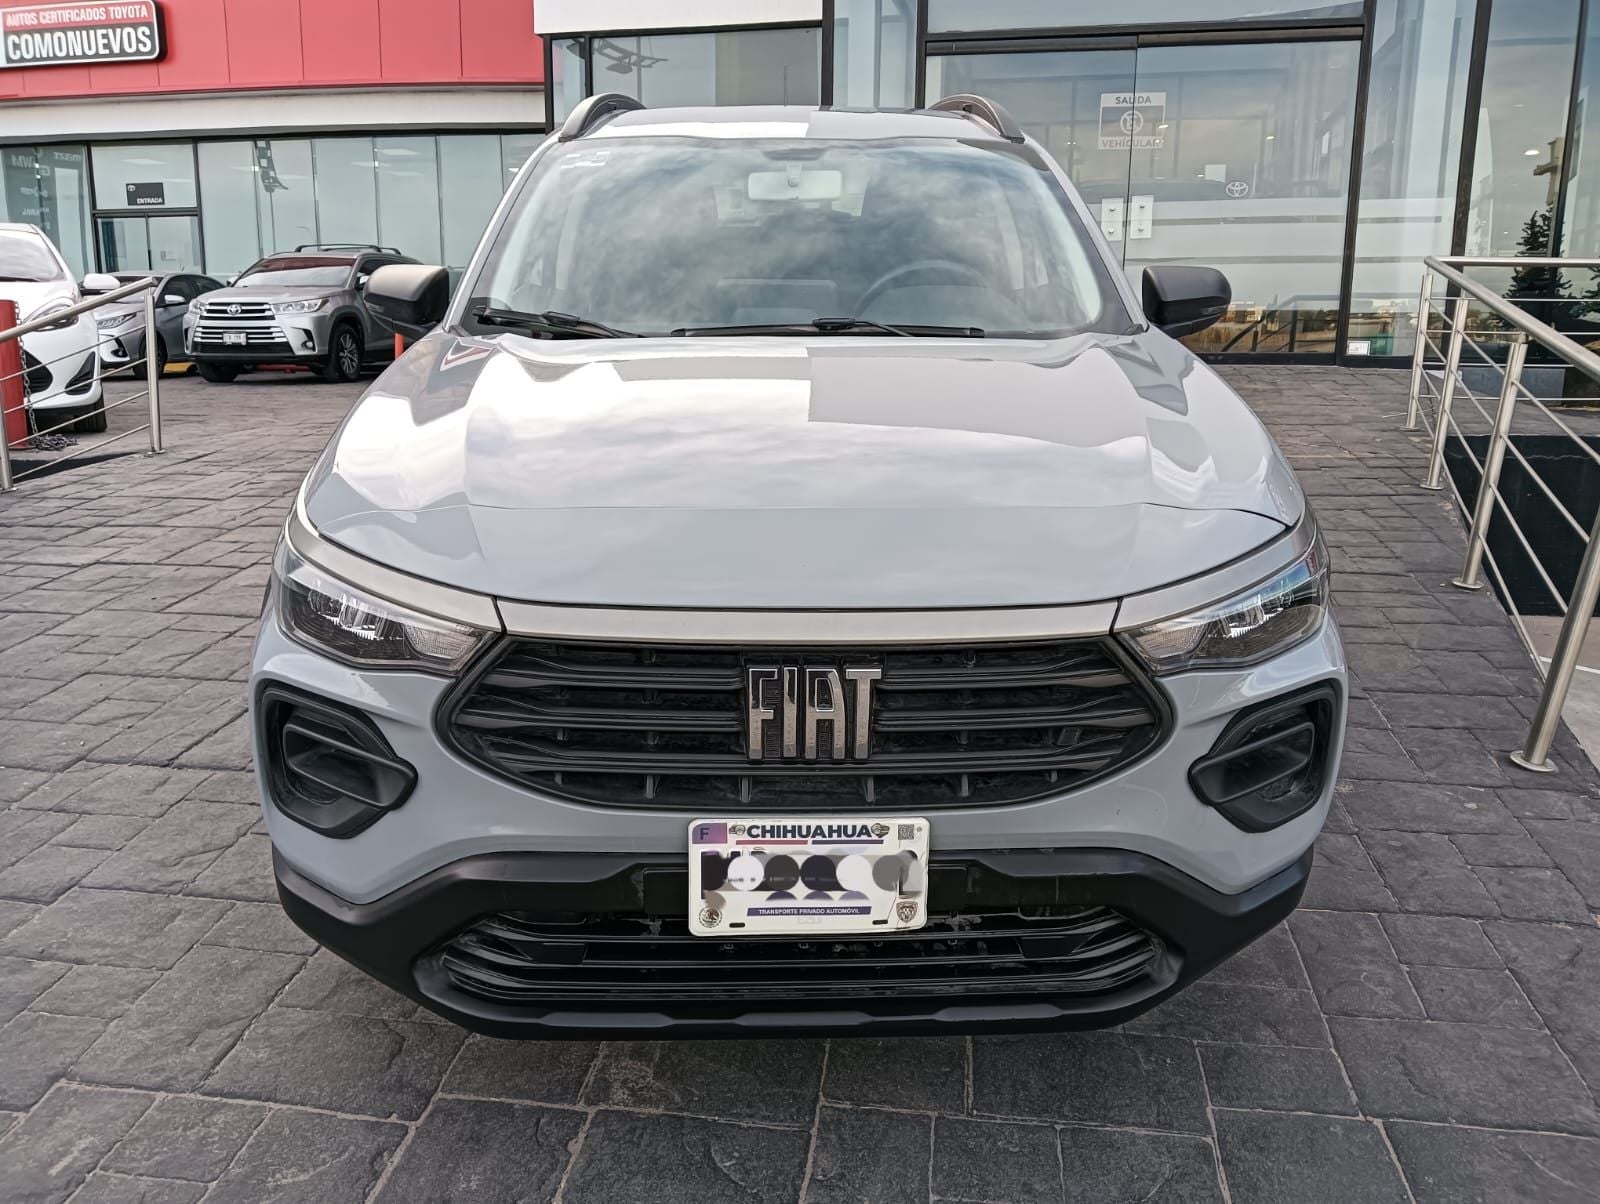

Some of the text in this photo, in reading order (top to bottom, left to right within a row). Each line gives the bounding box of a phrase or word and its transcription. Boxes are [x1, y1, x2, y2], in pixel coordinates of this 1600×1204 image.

[6, 5, 149, 27] AUTOS CERTIFICADOS TOYOTA
[7, 26, 152, 60] COMONUEVOS
[136, 197, 164, 205] ENTRADA
[749, 667, 882, 760] FIAT
[699, 827, 711, 841] F
[746, 824, 872, 839] CHIHUAHUA
